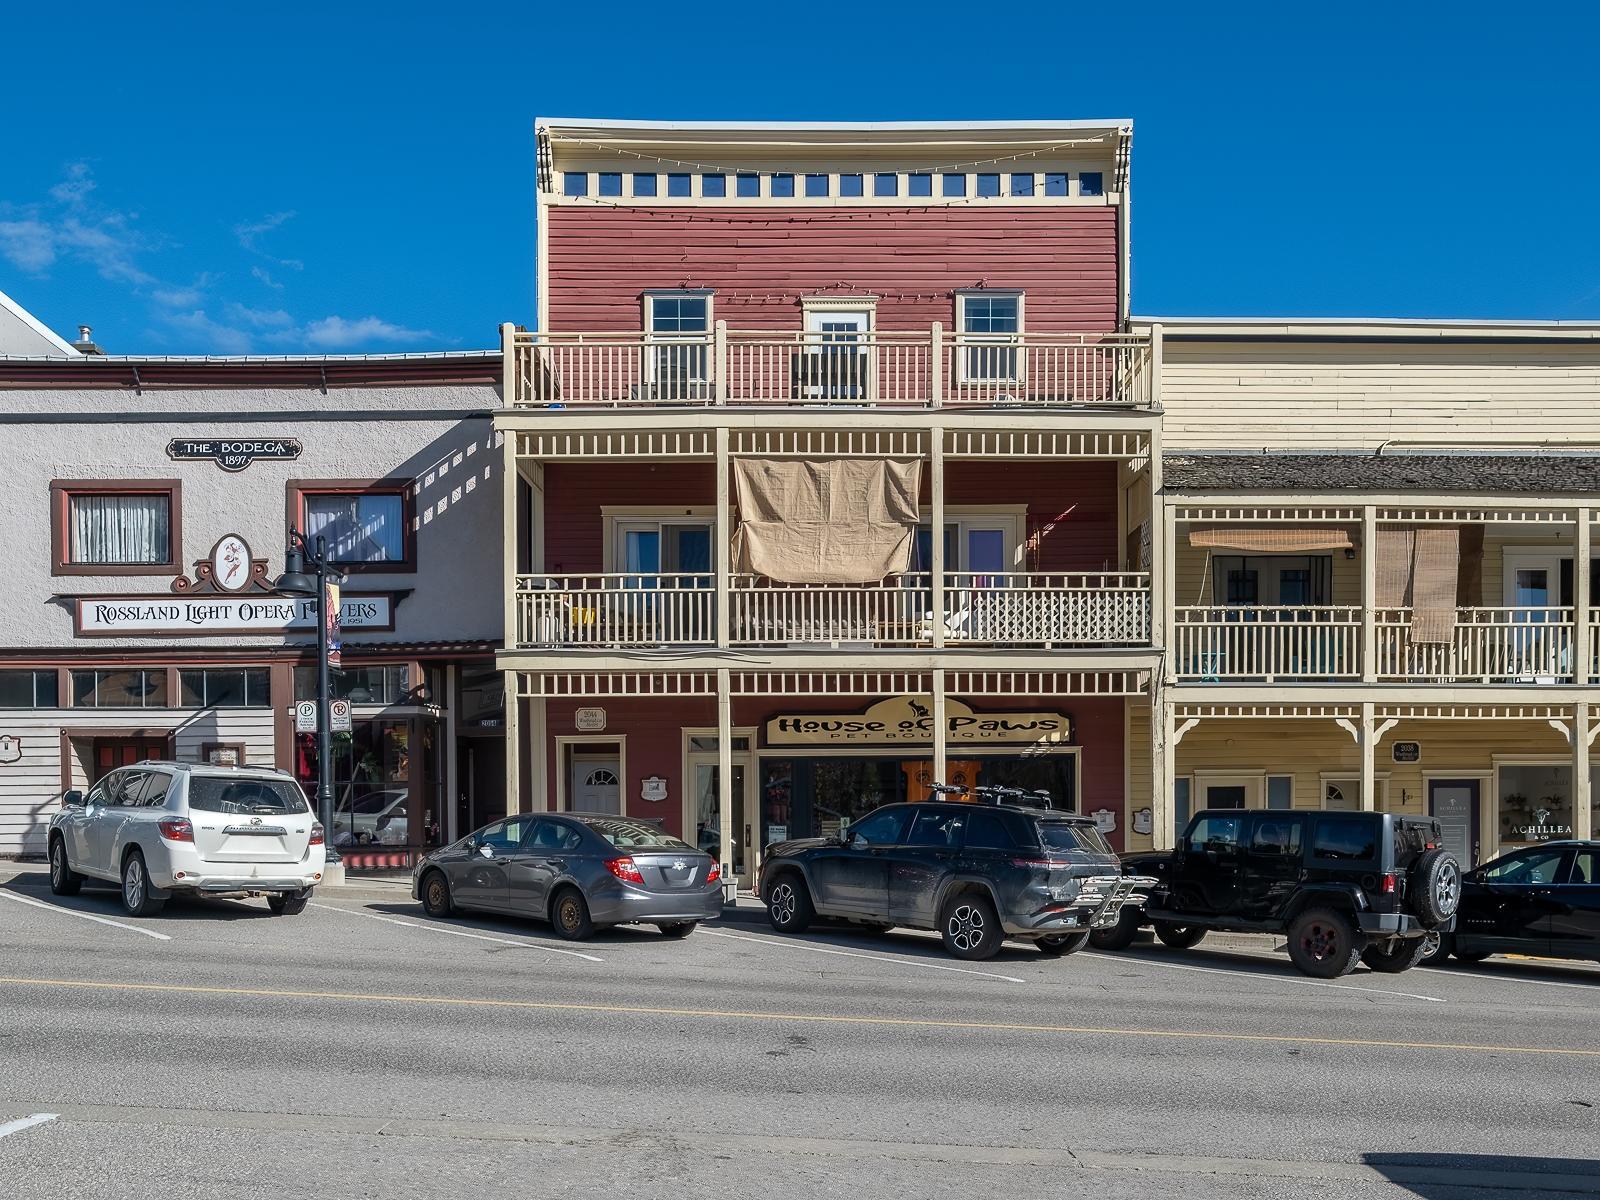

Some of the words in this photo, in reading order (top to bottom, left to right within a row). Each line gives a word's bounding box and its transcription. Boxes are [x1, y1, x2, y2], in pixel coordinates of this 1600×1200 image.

[184, 443, 212, 453] THE
[221, 442, 286, 455] BODEGA
[225, 455, 246, 465] 1897
[95, 604, 180, 625] ROSSLAND
[185, 603, 232, 625] LIGHT
[238, 603, 296, 622] OPERA
[779, 718, 886, 733] House
[898, 717, 935, 732] of
[948, 717, 1059, 731] Paws
[1511, 825, 1572, 834] ACHILLEA
